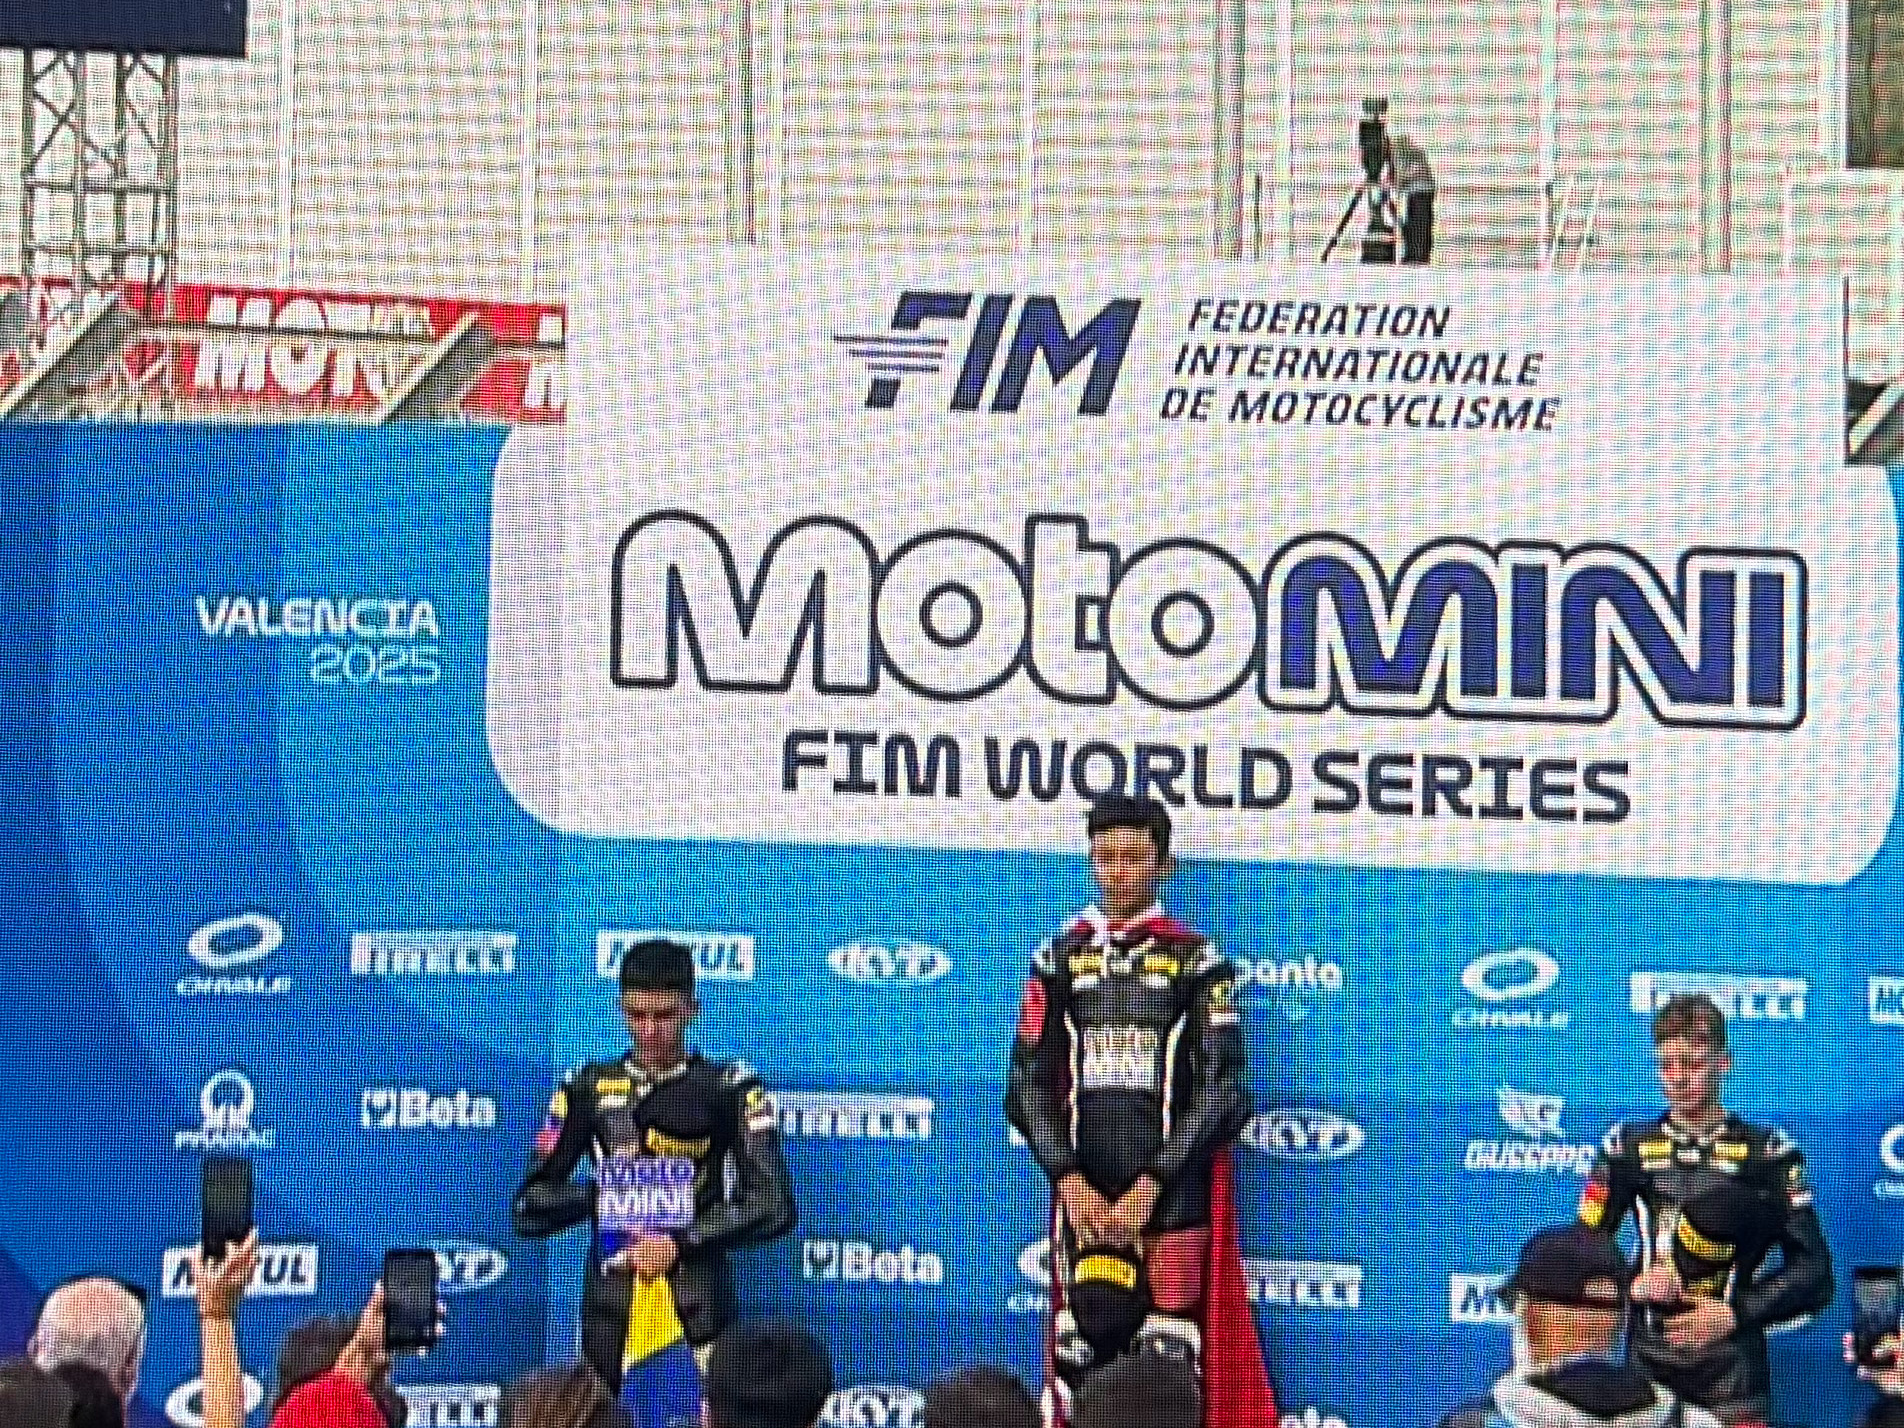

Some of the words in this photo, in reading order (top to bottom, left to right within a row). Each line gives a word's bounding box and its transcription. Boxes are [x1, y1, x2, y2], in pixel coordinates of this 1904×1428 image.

[1188, 298, 1452, 340] FEDERATION
[861, 290, 1143, 416] FIM
[1172, 342, 1544, 386] INTERNATIONALE
[1159, 389, 1216, 424] DE
[1228, 392, 1559, 434] MOTOCYCLISME
[196, 594, 440, 639] VALENCIA
[309, 644, 441, 686] 2025
[781, 730, 963, 799] FIM
[981, 734, 1293, 813] WORLD
[1312, 748, 1633, 824] SERIES
[841, 1244, 943, 1284] Beta
